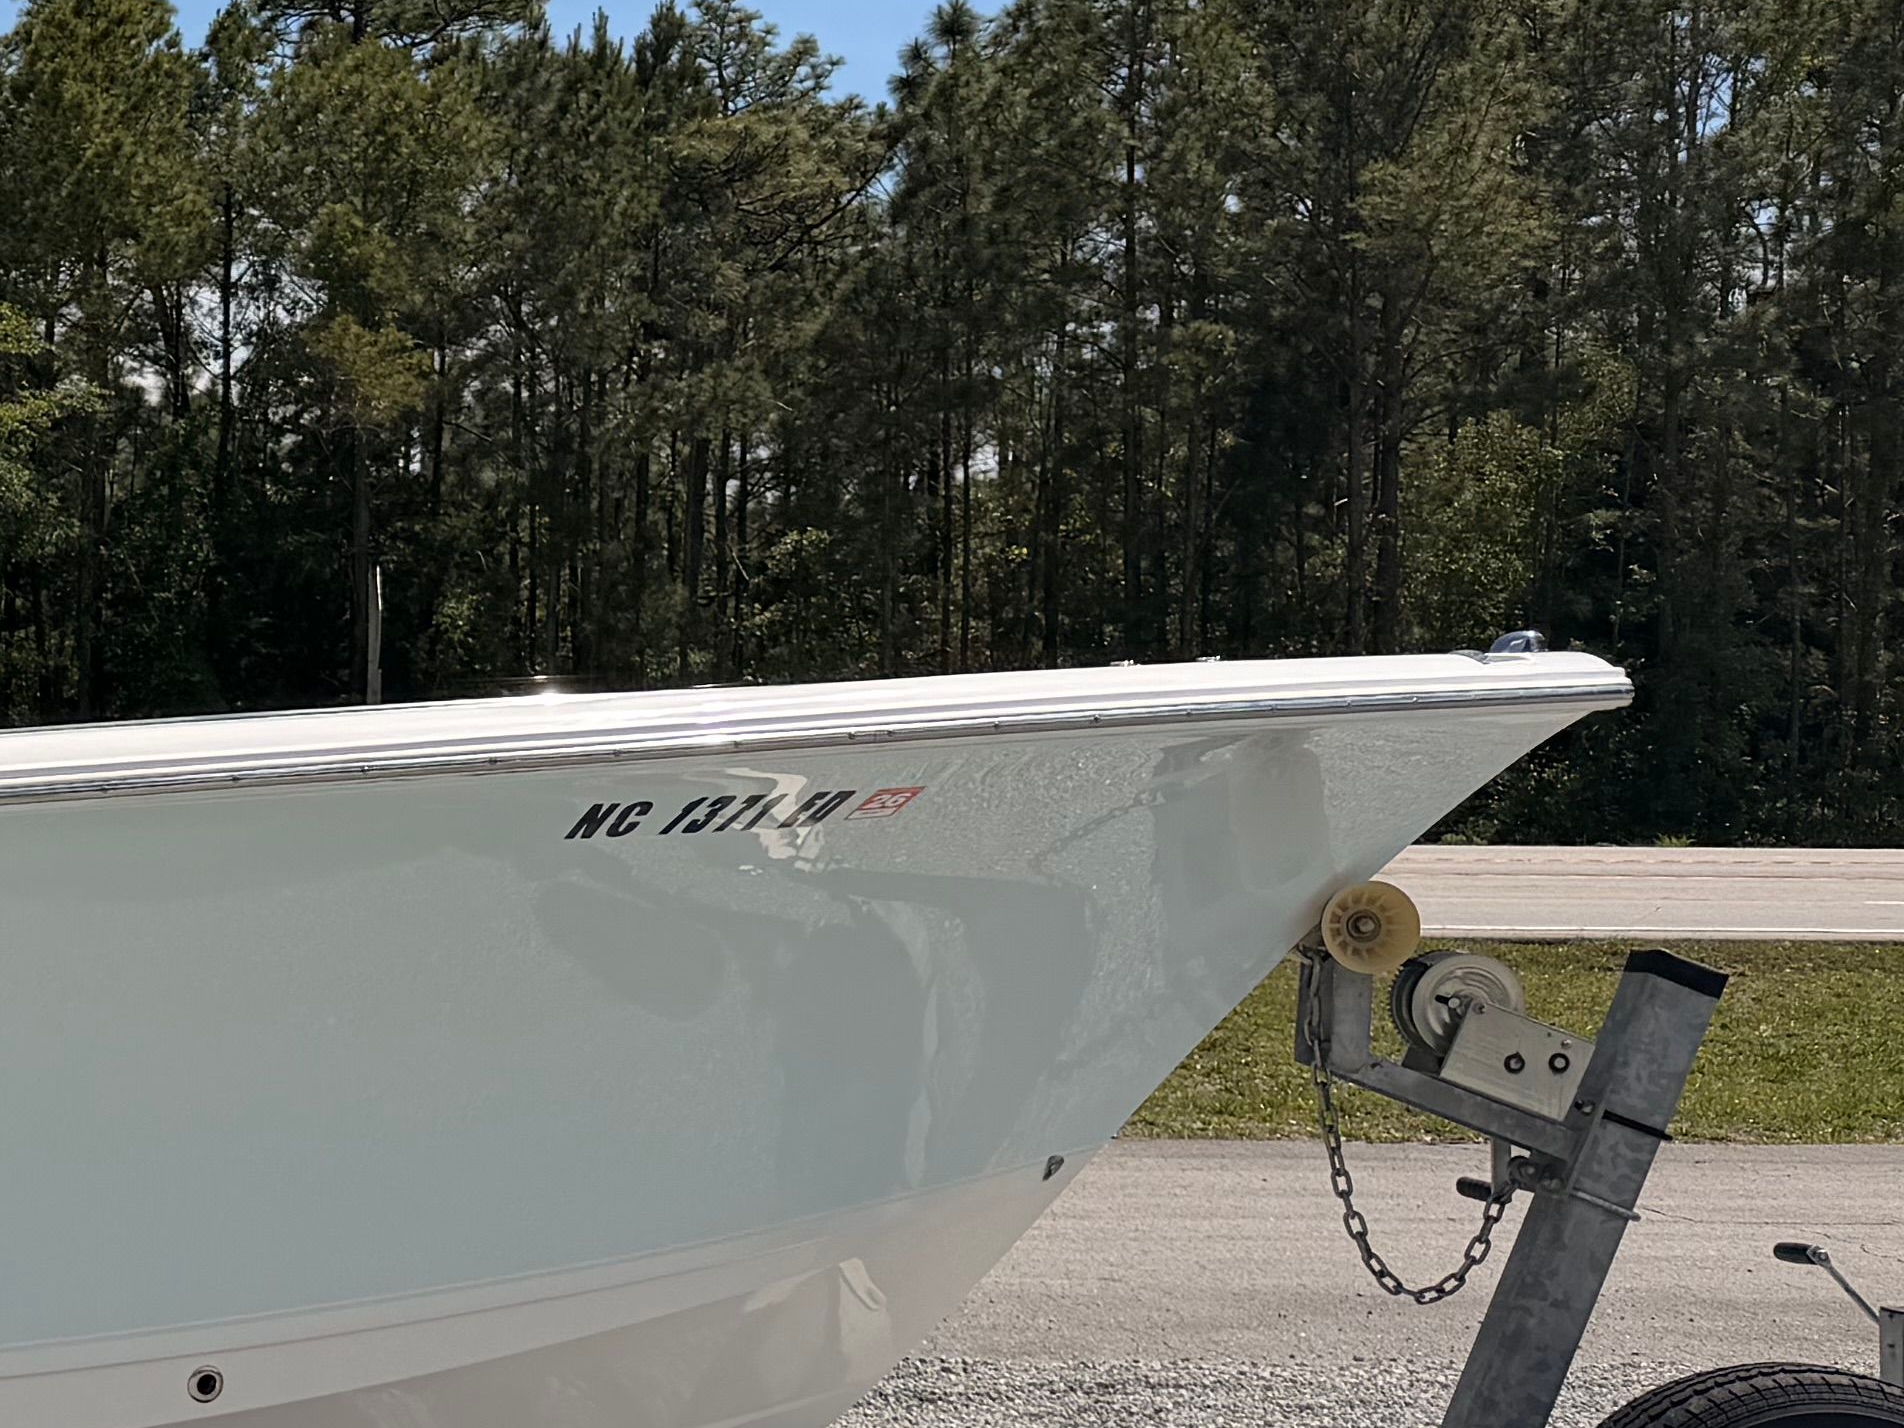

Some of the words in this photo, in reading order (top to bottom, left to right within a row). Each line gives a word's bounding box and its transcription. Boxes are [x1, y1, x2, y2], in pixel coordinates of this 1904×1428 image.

[564, 800, 654, 839] NC
[658, 793, 789, 835] 1371
[861, 793, 911, 810] 26
